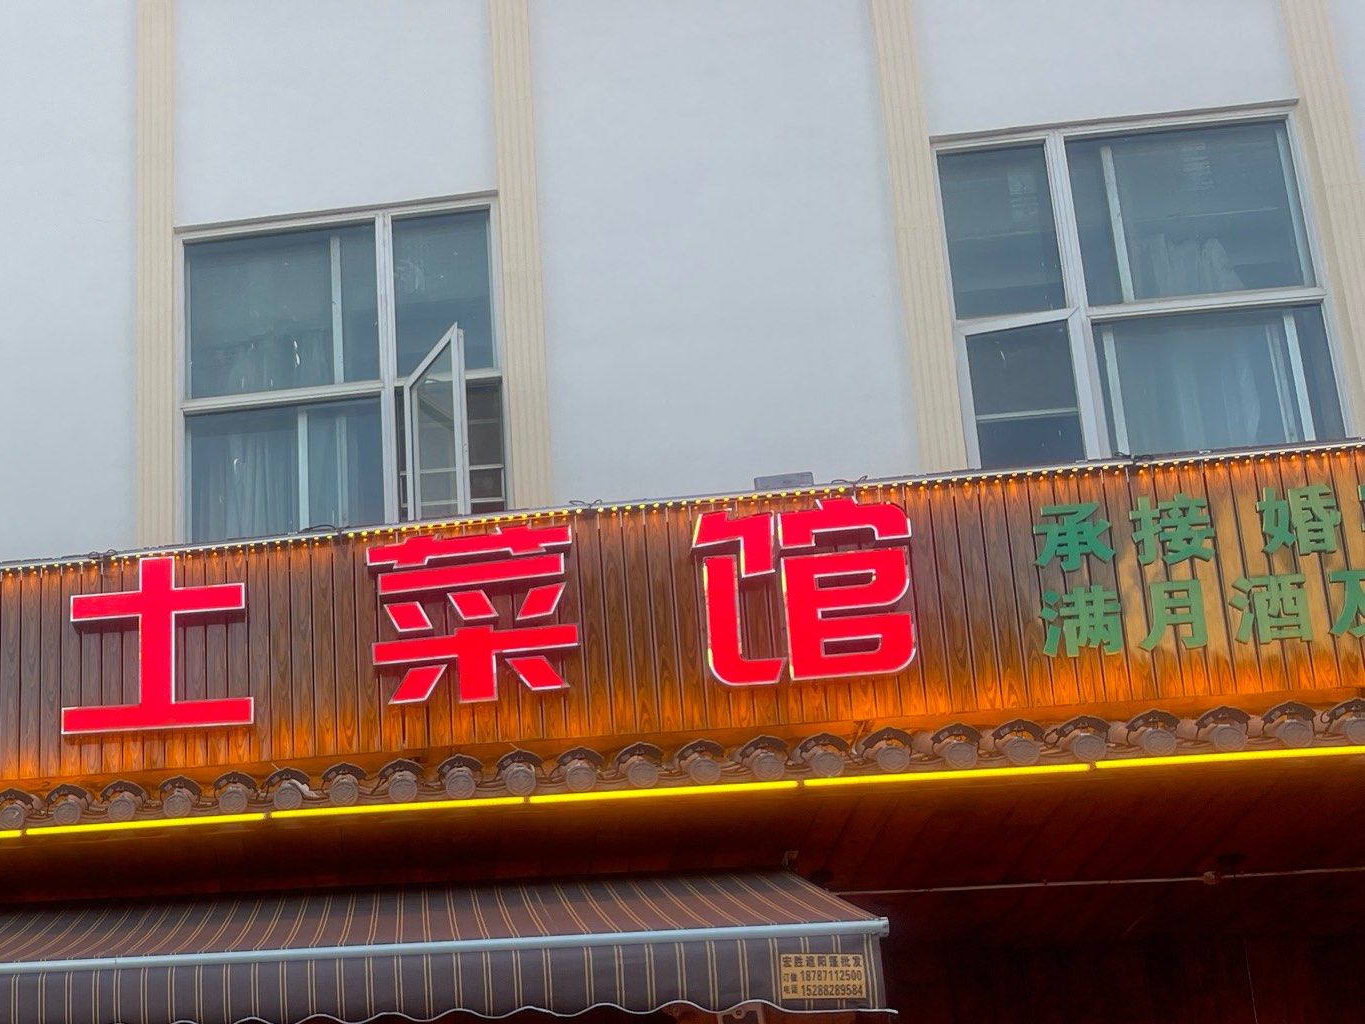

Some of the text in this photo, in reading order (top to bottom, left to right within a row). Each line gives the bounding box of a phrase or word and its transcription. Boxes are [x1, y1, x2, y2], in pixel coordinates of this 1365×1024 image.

[1033, 483, 1365, 572] 承接婚
[800, 970, 862, 982] 18787112500
